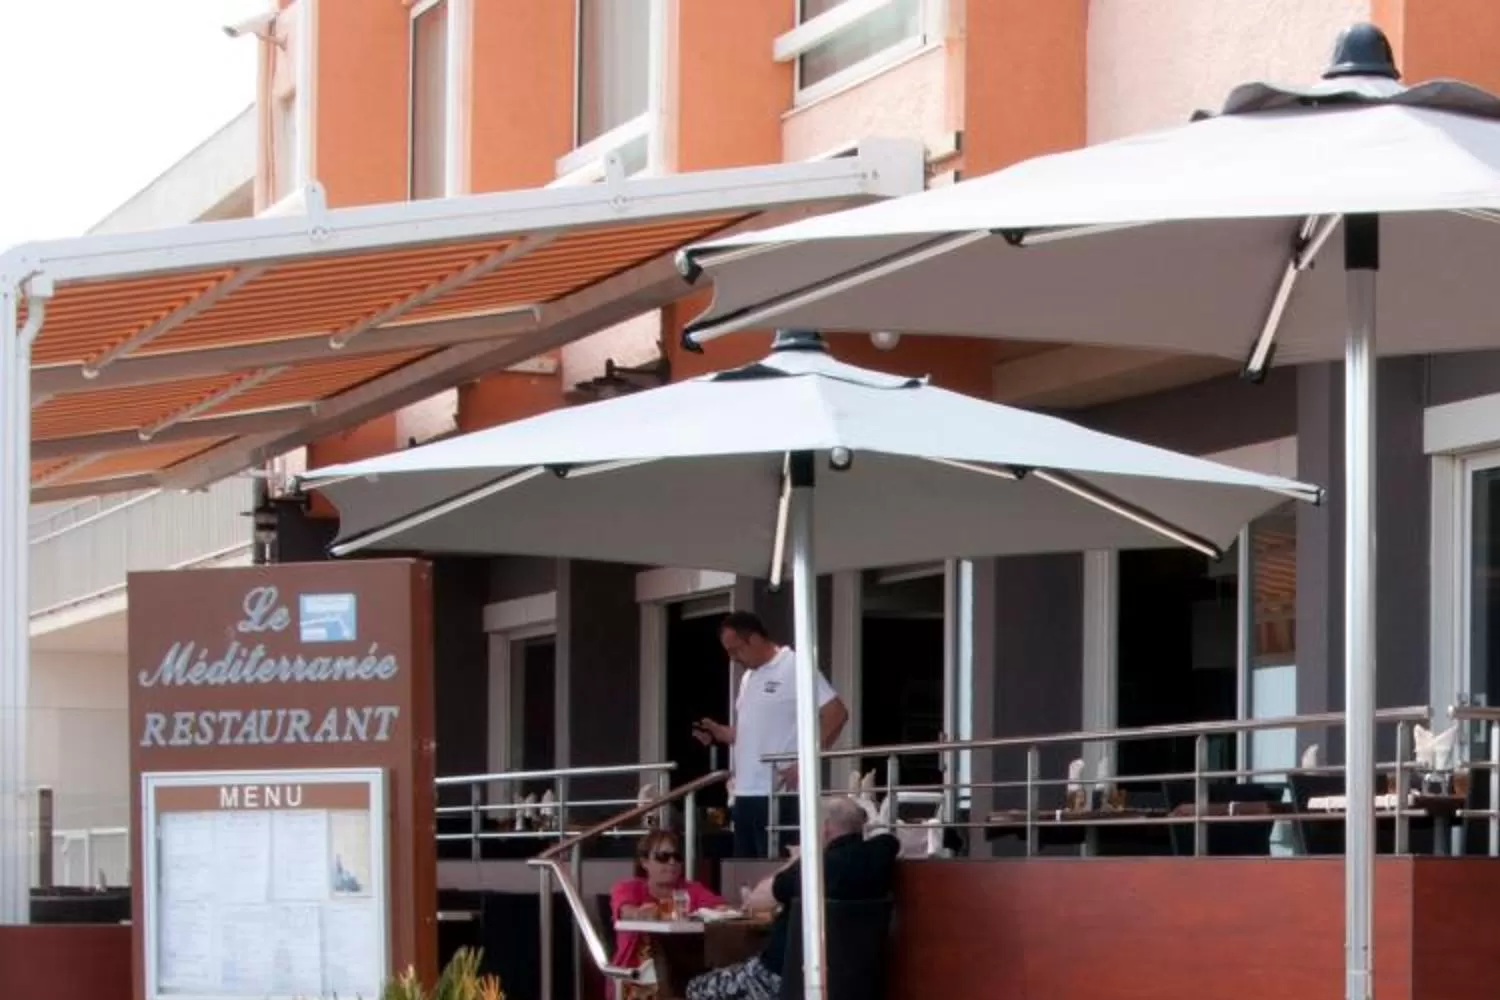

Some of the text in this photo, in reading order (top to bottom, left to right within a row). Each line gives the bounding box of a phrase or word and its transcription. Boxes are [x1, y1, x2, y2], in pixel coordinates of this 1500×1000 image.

[237, 585, 291, 633] Le
[138, 641, 399, 687] Méditerranée
[140, 705, 401, 746] RESTAURANT
[220, 785, 303, 808] MENU
